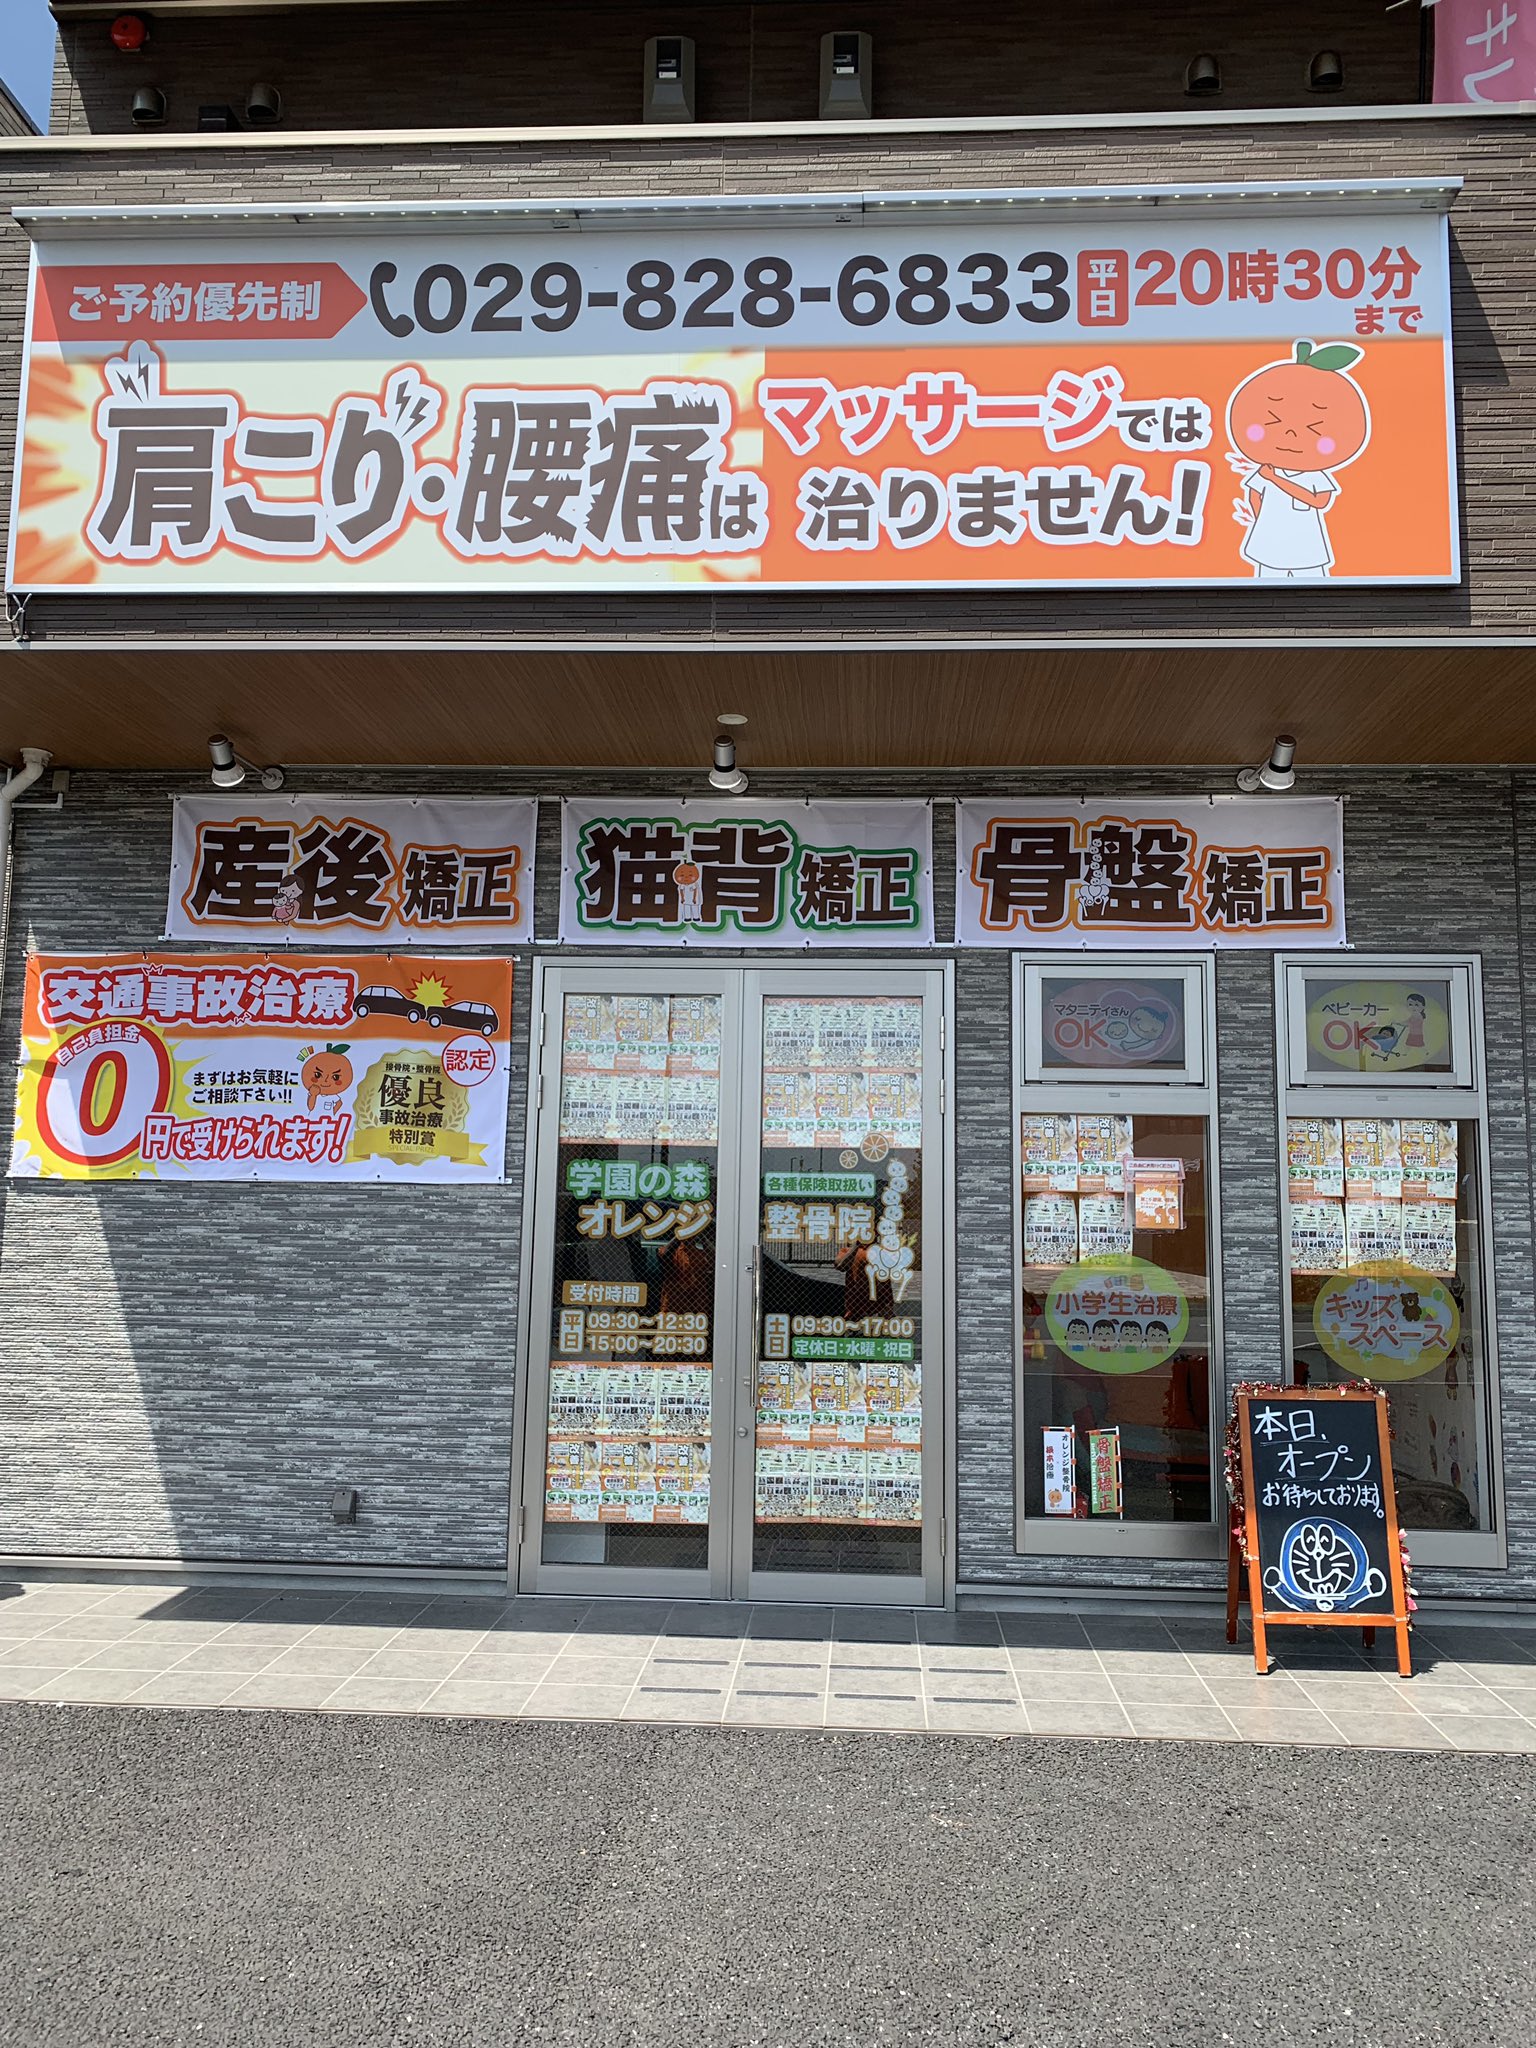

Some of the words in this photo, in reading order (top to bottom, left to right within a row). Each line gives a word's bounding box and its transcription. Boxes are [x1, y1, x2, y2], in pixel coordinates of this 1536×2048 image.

[413, 250, 1070, 334] 029-828-6833
[1135, 245, 1422, 306] 20時30分
[67, 279, 322, 323] ご予約優先制
[1354, 304, 1423, 334] まで
[765, 372, 1204, 446] マッサージでは
[806, 469, 1204, 543] 治りません!
[48, 972, 353, 1022] 交通事故治療
[56, 1024, 140, 1066] 自己負担金
[1054, 1018, 1109, 1048] OK
[1323, 1020, 1381, 1051] OK
[194, 1069, 299, 1087] まずはお気軽に
[385, 1062, 441, 1074] 接骨院・整骨院
[446, 1047, 492, 1073] 認定
[79, 1050, 128, 1136] 0
[193, 1087, 293, 1104] ご相談下さい!!
[379, 1074, 445, 1110] 優良
[379, 1109, 444, 1128] 事故治療
[145, 1119, 348, 1161] 円で受けられます!
[389, 1129, 436, 1146] 特別賞
[569, 1161, 709, 1198] 学園の森
[768, 1176, 873, 1193] 各種保険取扱い
[578, 1201, 712, 1239] オレンジ
[766, 1204, 874, 1242] 整骨院
[569, 1284, 640, 1303] 受付時間
[1055, 1291, 1178, 1316] 小学生治療
[1326, 1293, 1398, 1320] キッズ
[562, 1311, 584, 1353] 平日
[1348, 1321, 1448, 1348] スペース
[1062, 1434, 1070, 1492] オレンジ整骨院
[1097, 1437, 1113, 1512] 骨盤矯正
[1277, 1443, 1372, 1481] オープン
[1262, 1482, 1385, 1519] お待ちしております。
